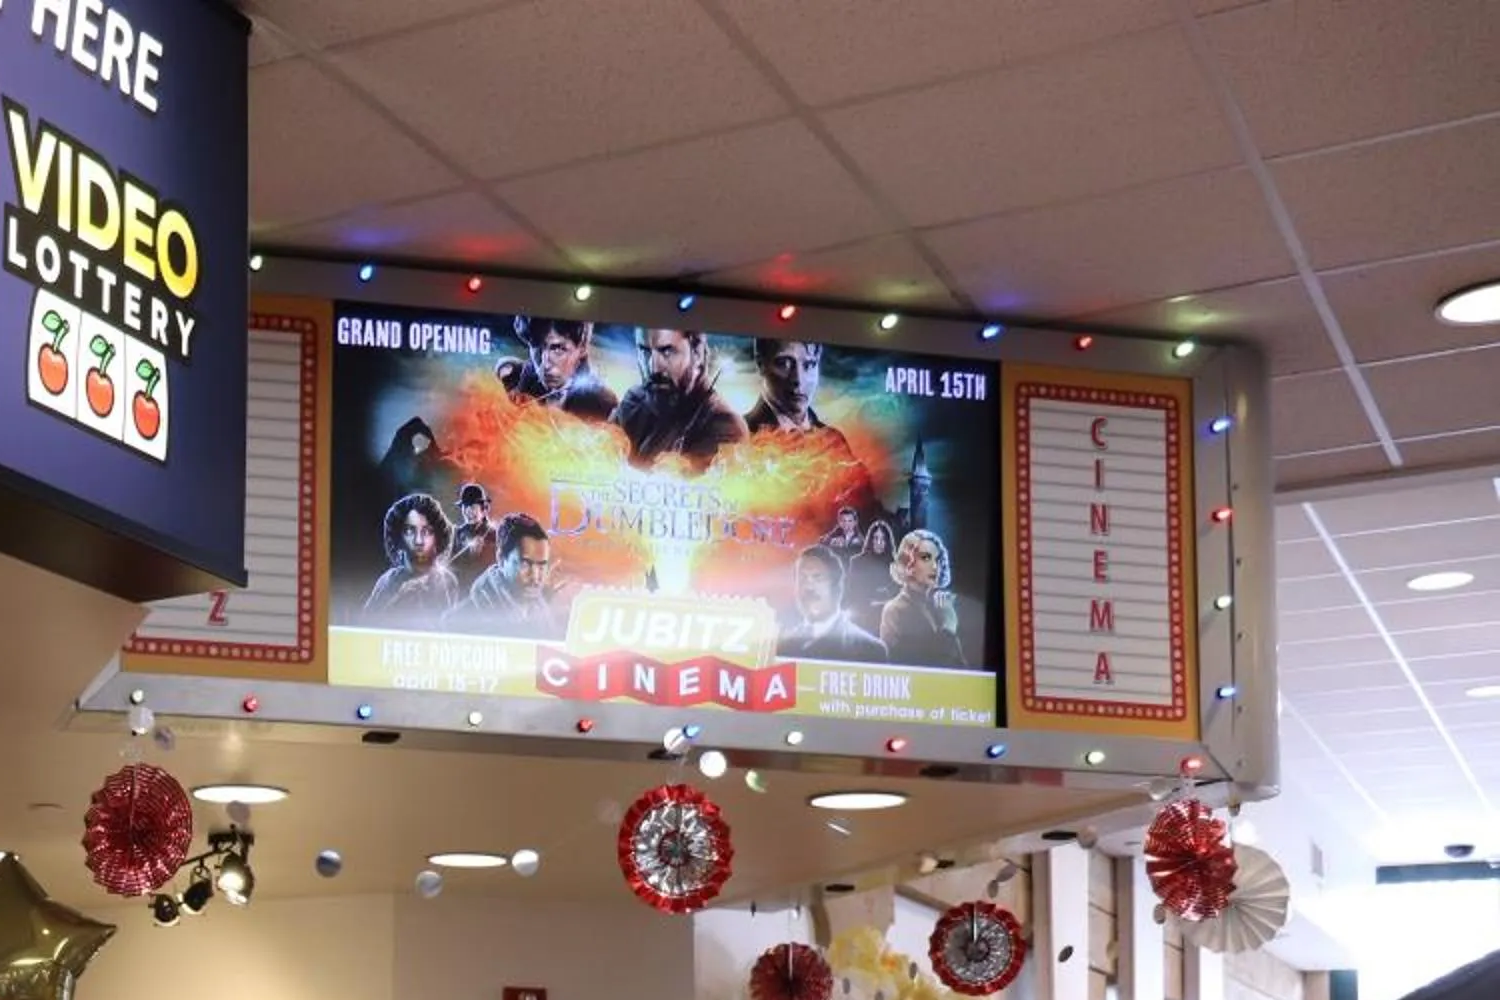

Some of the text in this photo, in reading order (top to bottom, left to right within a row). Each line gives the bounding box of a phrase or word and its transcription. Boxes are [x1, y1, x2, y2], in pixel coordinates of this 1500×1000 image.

[31, 0, 163, 113] HERE
[9, 109, 197, 298] VIDEO
[8, 217, 195, 356] LOTTERY
[337, 317, 491, 354] GRAND OPENING
[884, 367, 986, 401] APRIL 15TH
[613, 480, 722, 508] SECRETS
[1090, 416, 1115, 685] CINEMA
[584, 606, 756, 655] JUBITZ
[542, 658, 789, 702] CINEMA
[819, 670, 911, 700] FREE DRINK
[819, 700, 991, 722] with purchase of ticket
